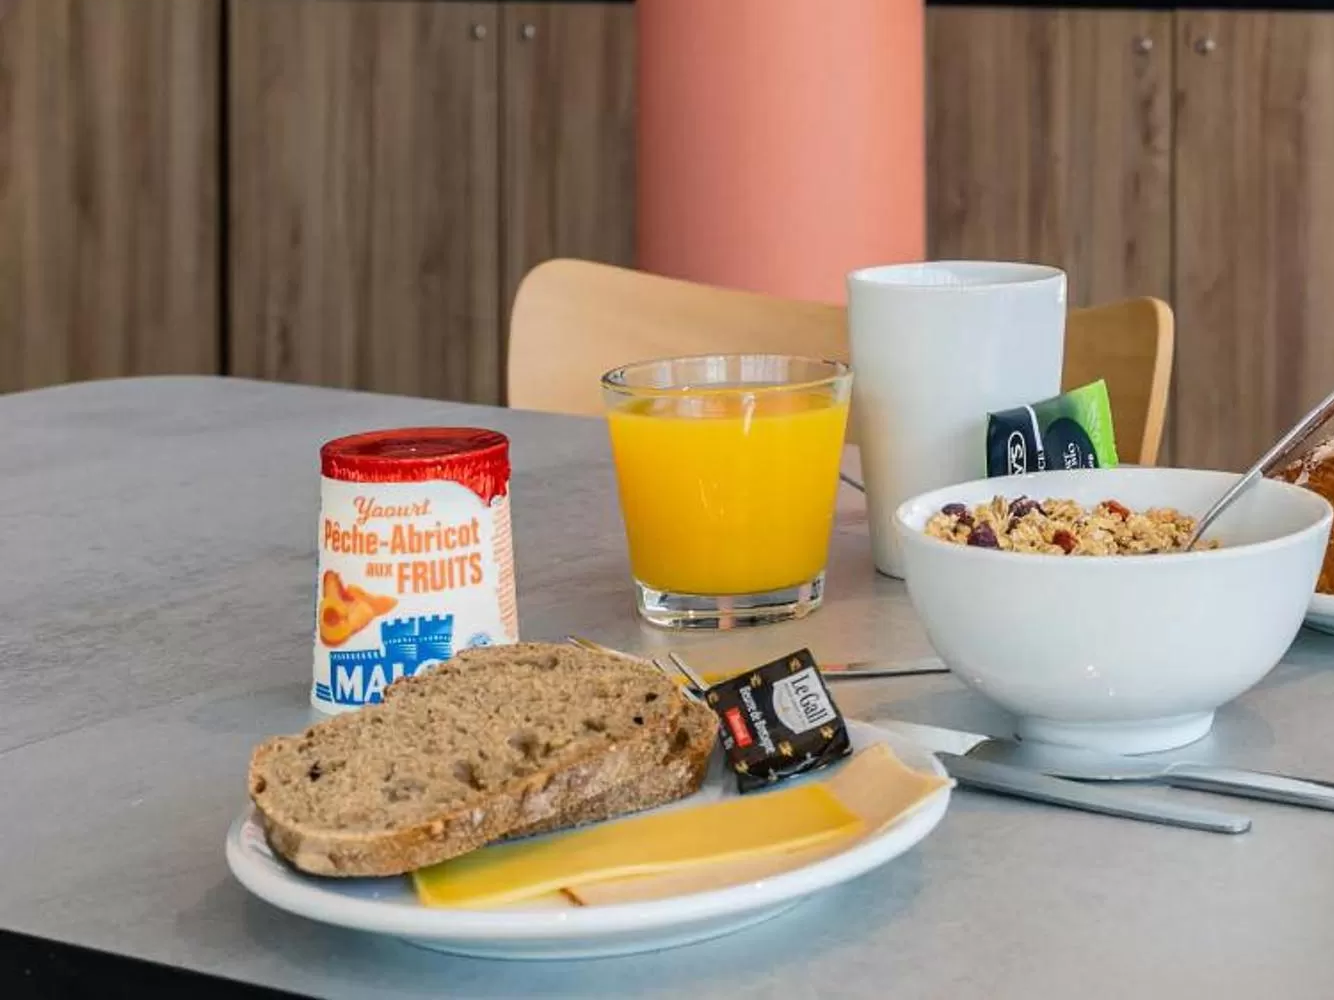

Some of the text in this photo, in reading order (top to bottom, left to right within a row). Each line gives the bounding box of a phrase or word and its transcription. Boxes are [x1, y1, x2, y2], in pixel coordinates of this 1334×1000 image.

[353, 495, 430, 525] Yaourt
[325, 516, 480, 555] Pêche-Abricot
[397, 552, 483, 593] FRUITS
